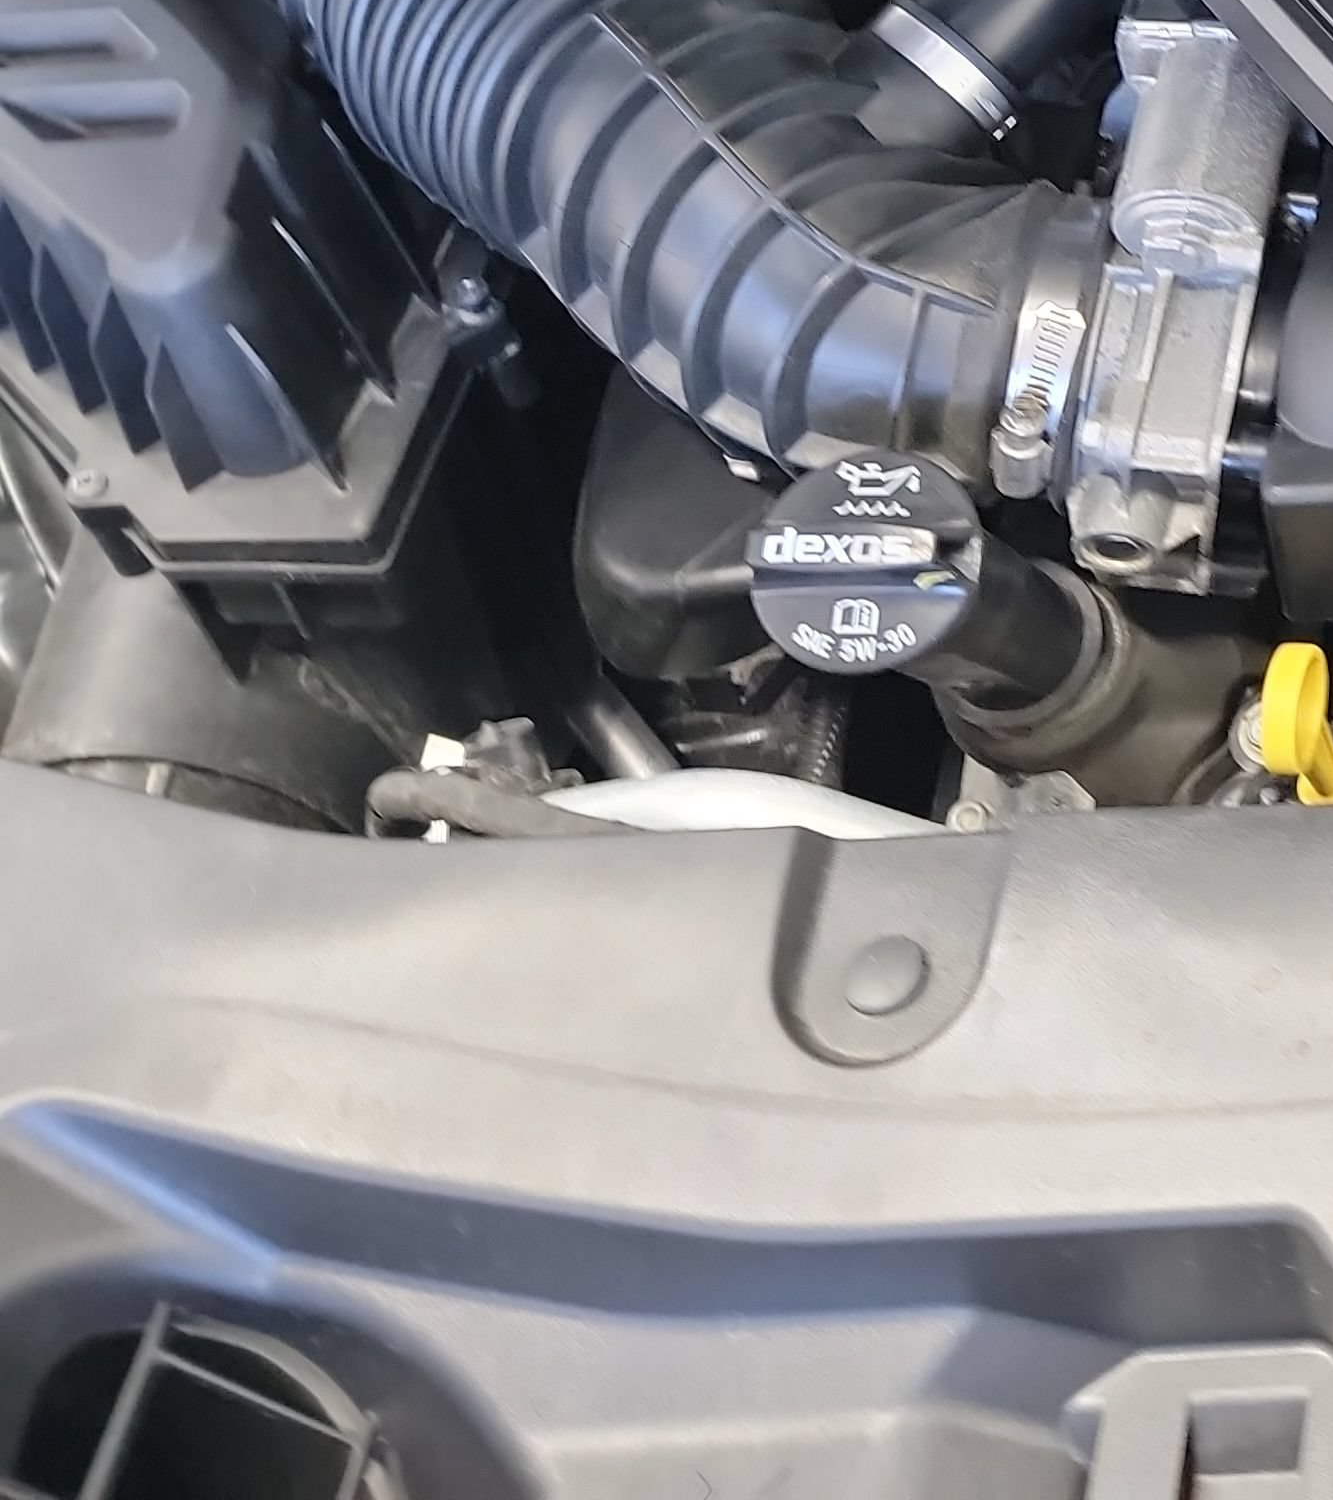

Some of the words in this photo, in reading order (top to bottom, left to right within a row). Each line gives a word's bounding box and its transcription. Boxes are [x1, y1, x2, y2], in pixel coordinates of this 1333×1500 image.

[763, 526, 913, 564] dexos
[791, 623, 836, 660] SAE
[837, 623, 917, 663] 5W-30
